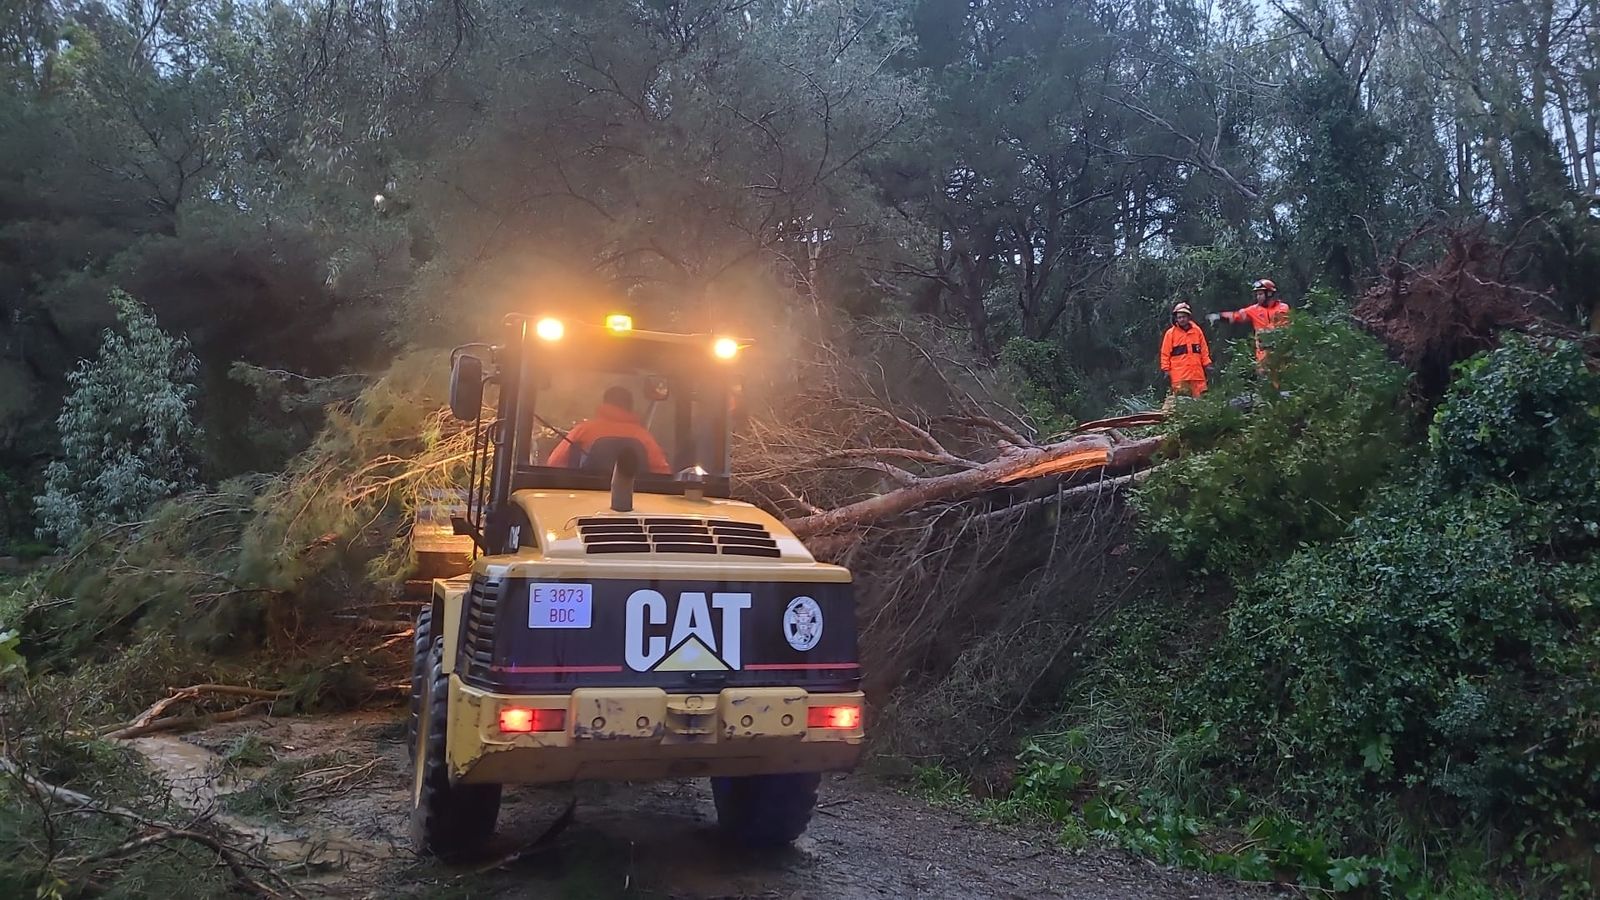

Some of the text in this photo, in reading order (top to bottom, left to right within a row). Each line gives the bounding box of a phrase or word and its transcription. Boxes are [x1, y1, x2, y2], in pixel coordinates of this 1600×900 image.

[534, 589, 583, 603] E 3873
[549, 608, 575, 622] BDC
[625, 589, 751, 672] CAT
